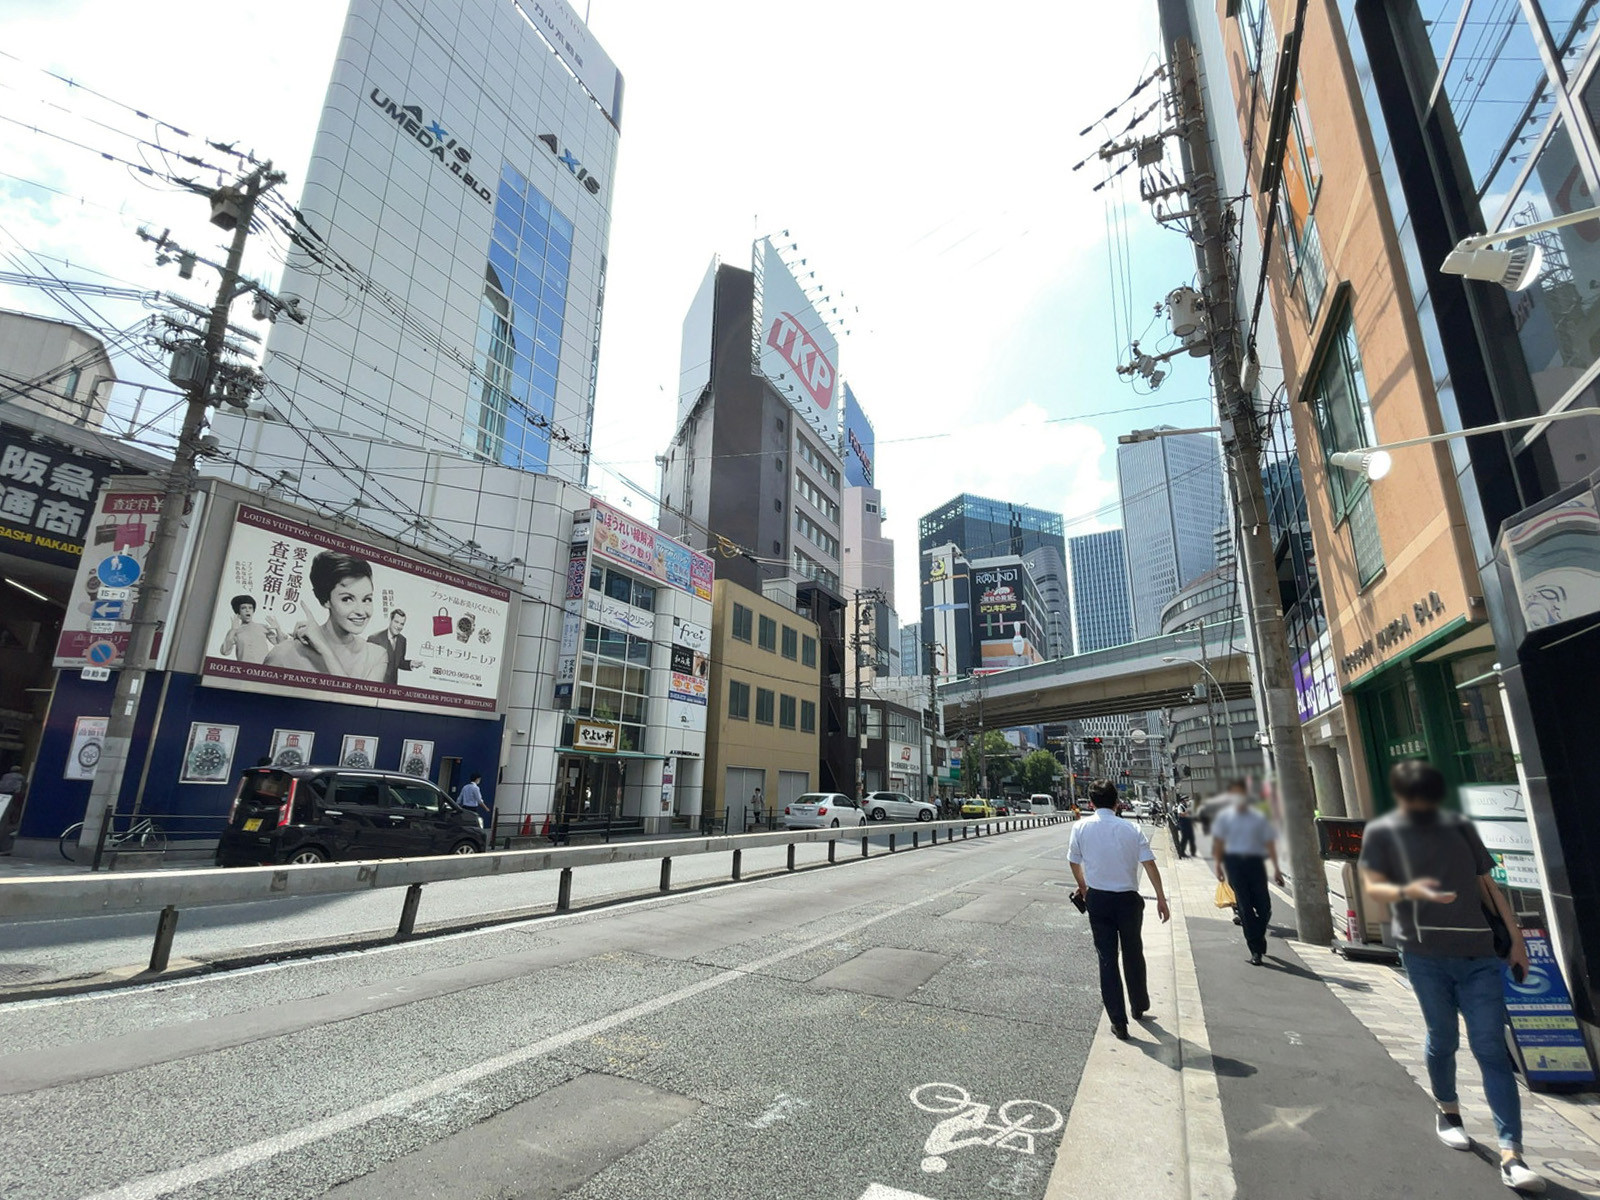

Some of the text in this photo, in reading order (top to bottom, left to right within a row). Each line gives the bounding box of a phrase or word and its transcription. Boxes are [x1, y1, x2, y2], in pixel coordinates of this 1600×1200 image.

[402, 104, 472, 164] AXIS
[538, 132, 601, 195] AXIS
[774, 320, 832, 394] TKP
[243, 511, 271, 525] LOUIS
[272, 518, 312, 538] VUITTON
[314, 533, 347, 549] CHANEL
[349, 544, 381, 559] HERMES
[382, 554, 413, 570] CARTIER
[262, 540, 291, 611] 査定額!!
[281, 546, 309, 615] 愛と感動の
[679, 623, 707, 642] frei
[209, 662, 242, 674] ROLEX
[246, 668, 279, 679] OMEGA
[283, 673, 317, 685] FRANCK
[319, 679, 353, 689] MULLER
[355, 683, 387, 694] PANERAI
[404, 691, 439, 701] AUDEMARS
[205, 727, 222, 742] 高
[581, 729, 614, 744] やよい軒
